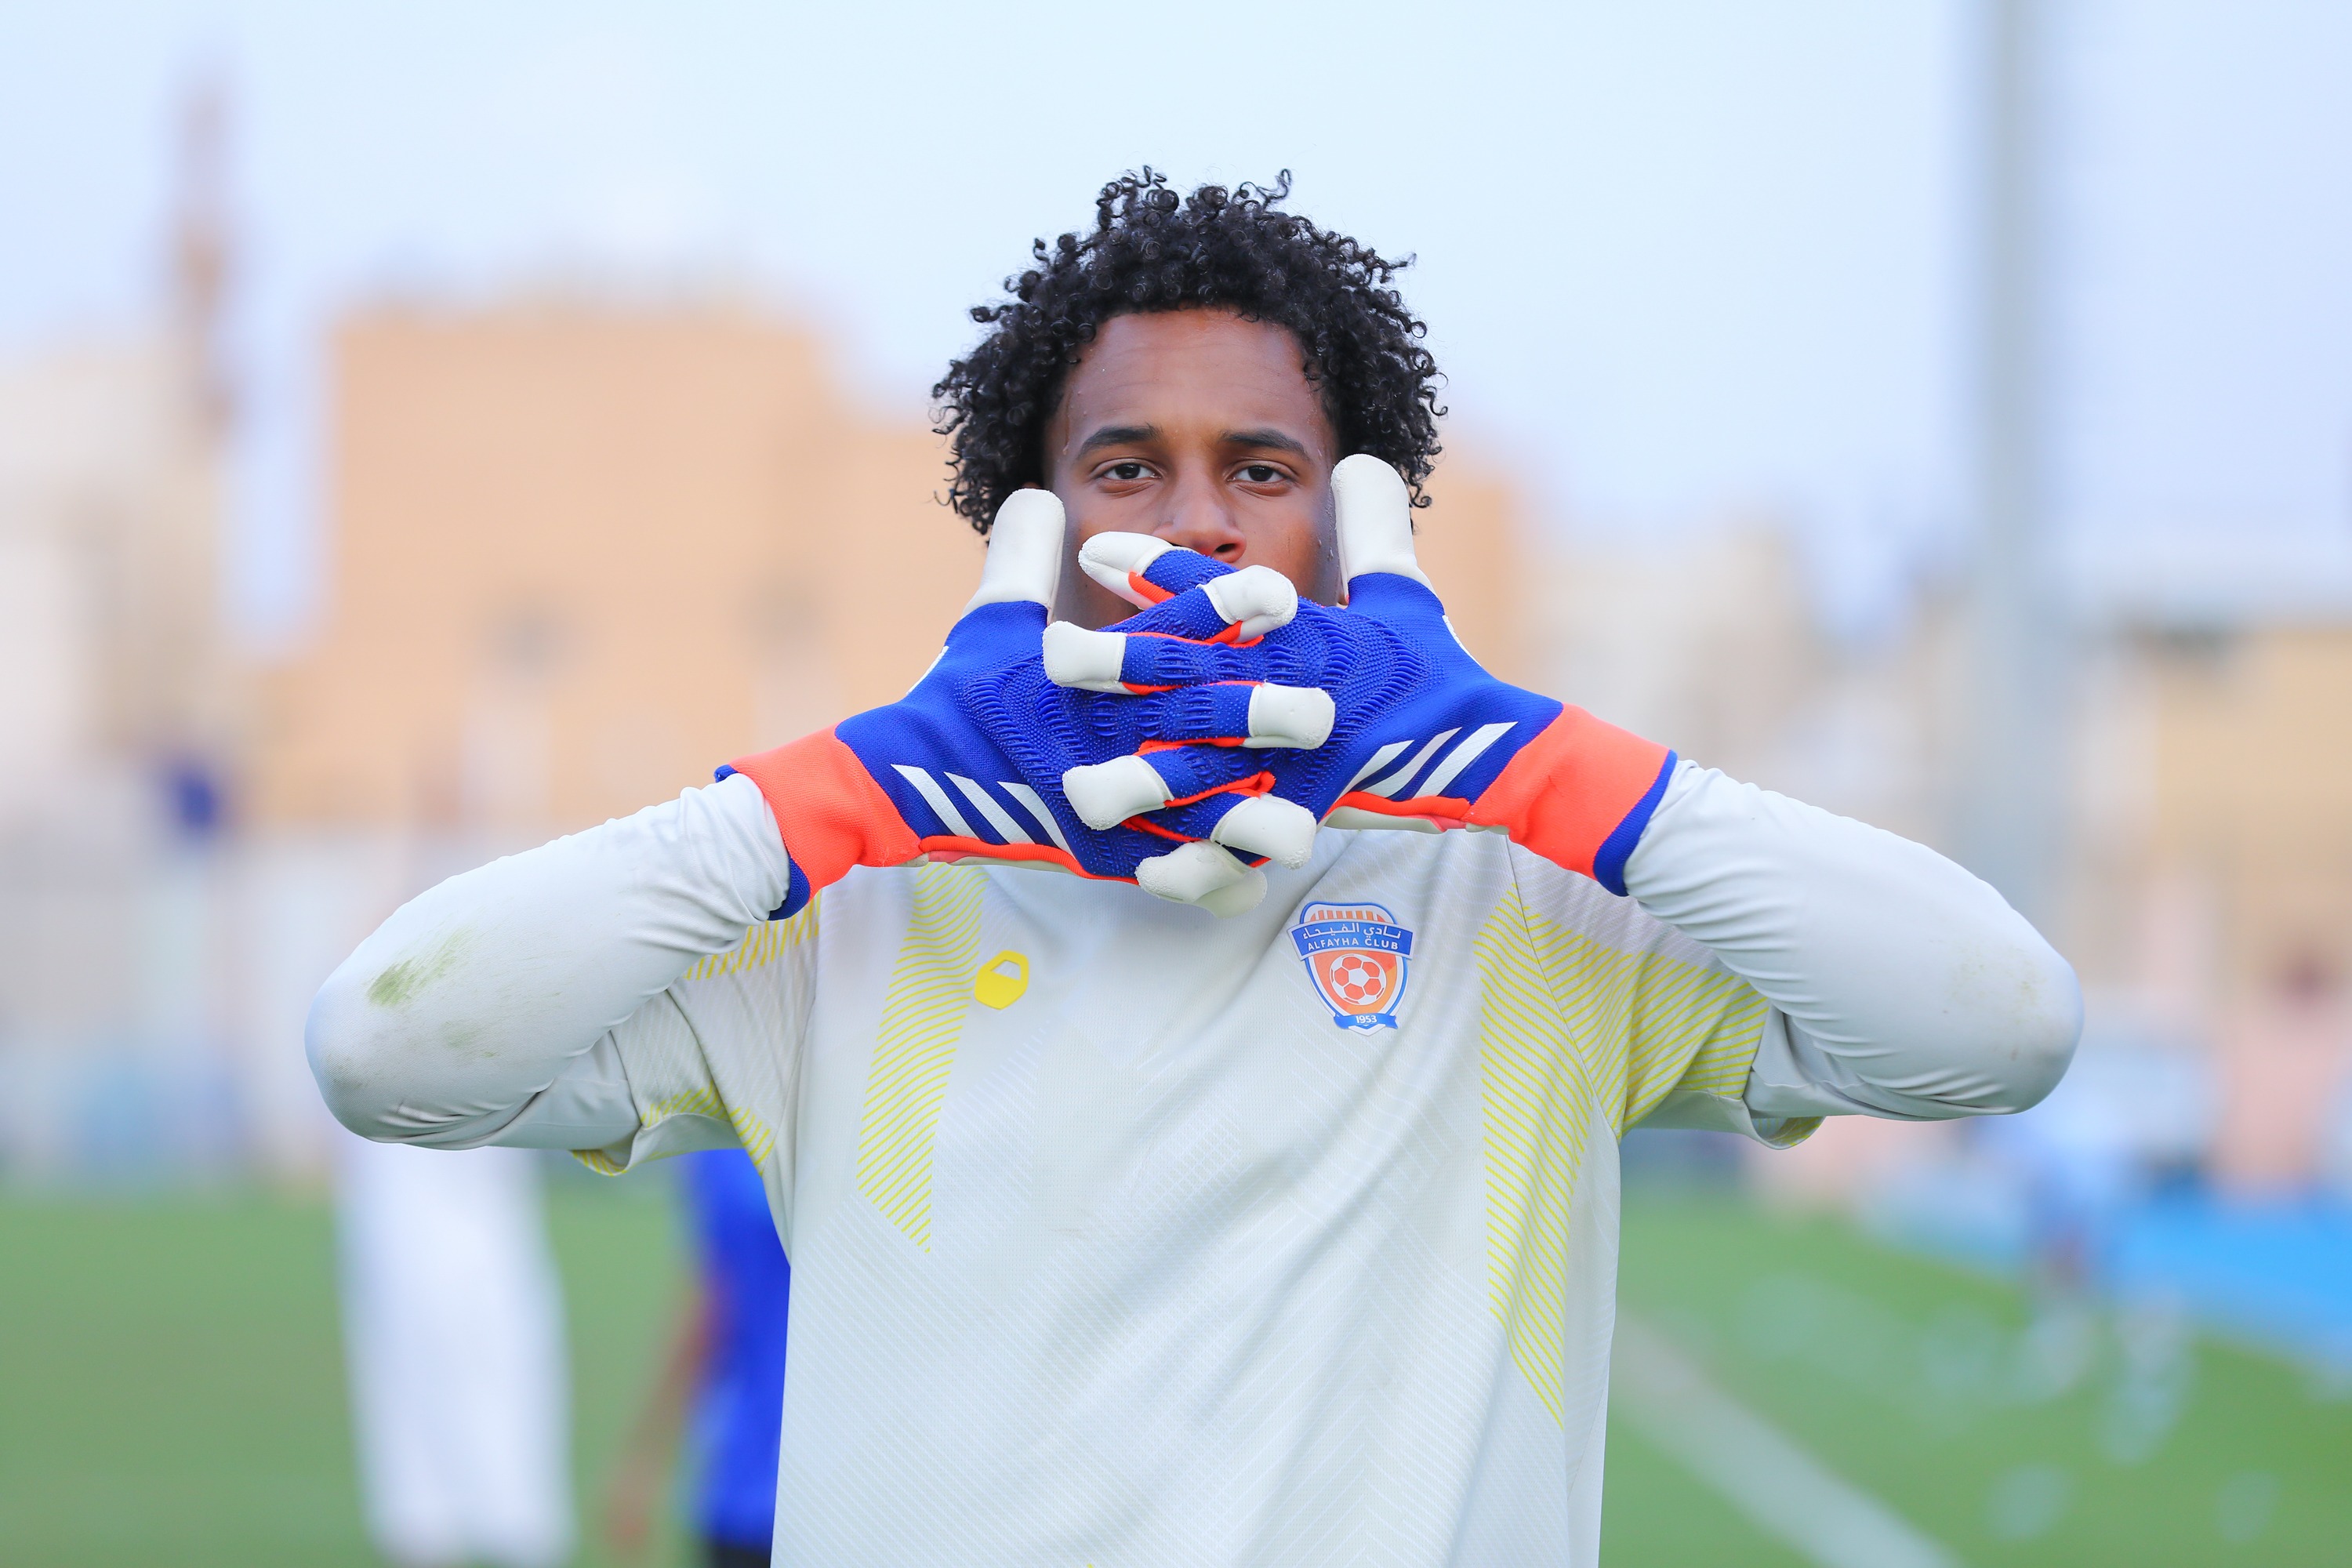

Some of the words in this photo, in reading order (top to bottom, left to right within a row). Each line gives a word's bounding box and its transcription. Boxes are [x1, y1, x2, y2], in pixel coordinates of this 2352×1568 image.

[1303, 923, 1359, 939] الفيحاء
[1363, 925, 1401, 939] نادي
[1308, 938, 1359, 951] ALFAYHA
[1365, 938, 1398, 950] CLUB
[1356, 1015, 1377, 1024] 1953
